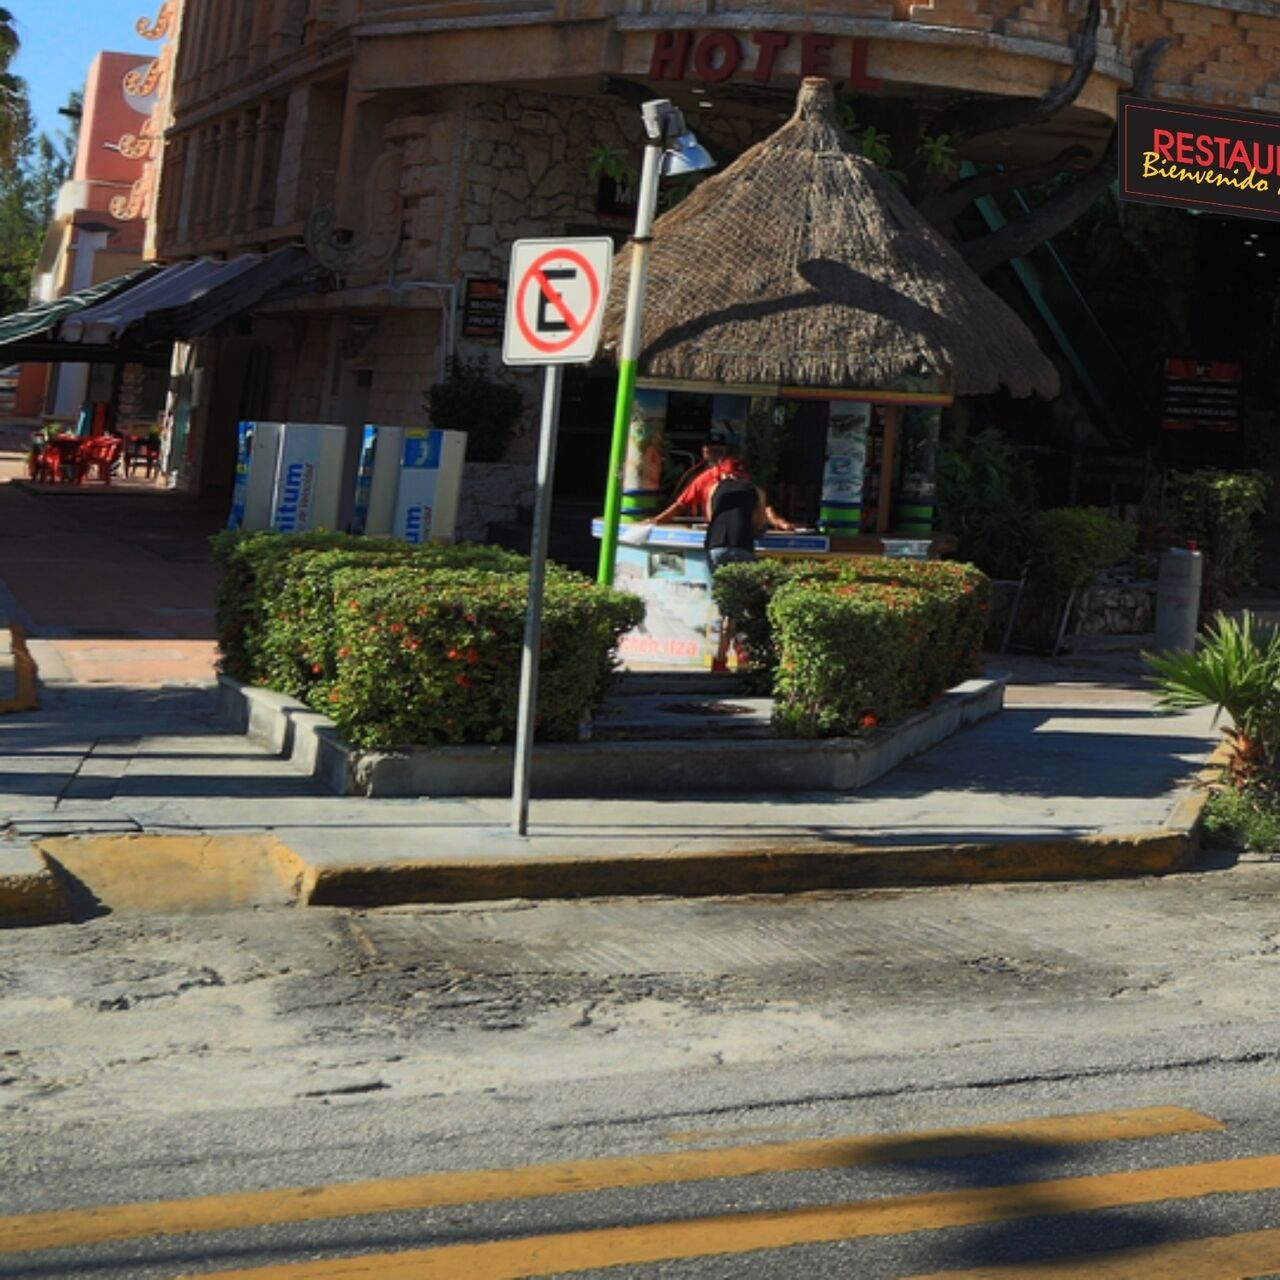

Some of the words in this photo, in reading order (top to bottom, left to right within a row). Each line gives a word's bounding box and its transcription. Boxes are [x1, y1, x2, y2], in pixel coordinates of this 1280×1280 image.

[650, 30, 881, 91] HOTEL
[1142, 151, 1268, 192] Bienvenido
[537, 269, 577, 332] E
[276, 463, 304, 533] nitum
